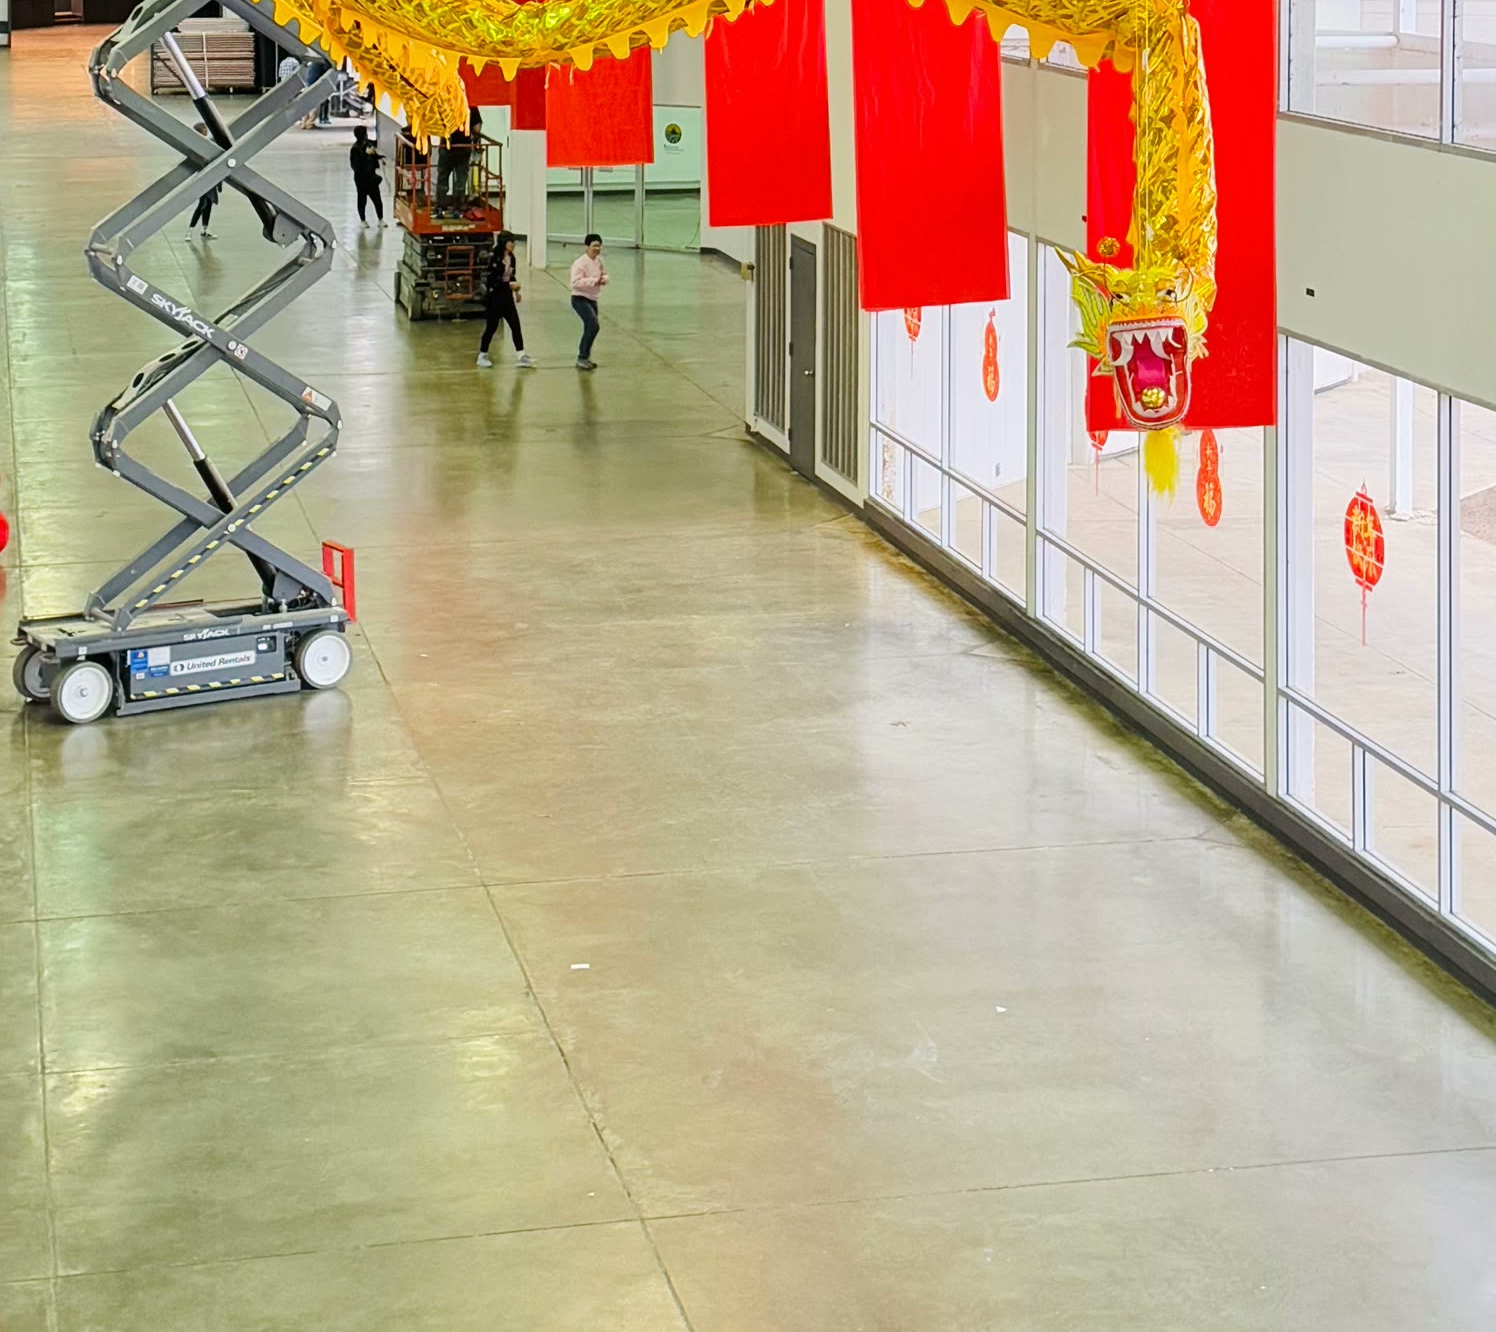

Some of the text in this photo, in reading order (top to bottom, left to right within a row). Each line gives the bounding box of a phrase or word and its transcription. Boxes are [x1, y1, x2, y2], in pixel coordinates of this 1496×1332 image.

[150, 293, 215, 339] SKYJACK
[186, 654, 251, 671] United Rentals
